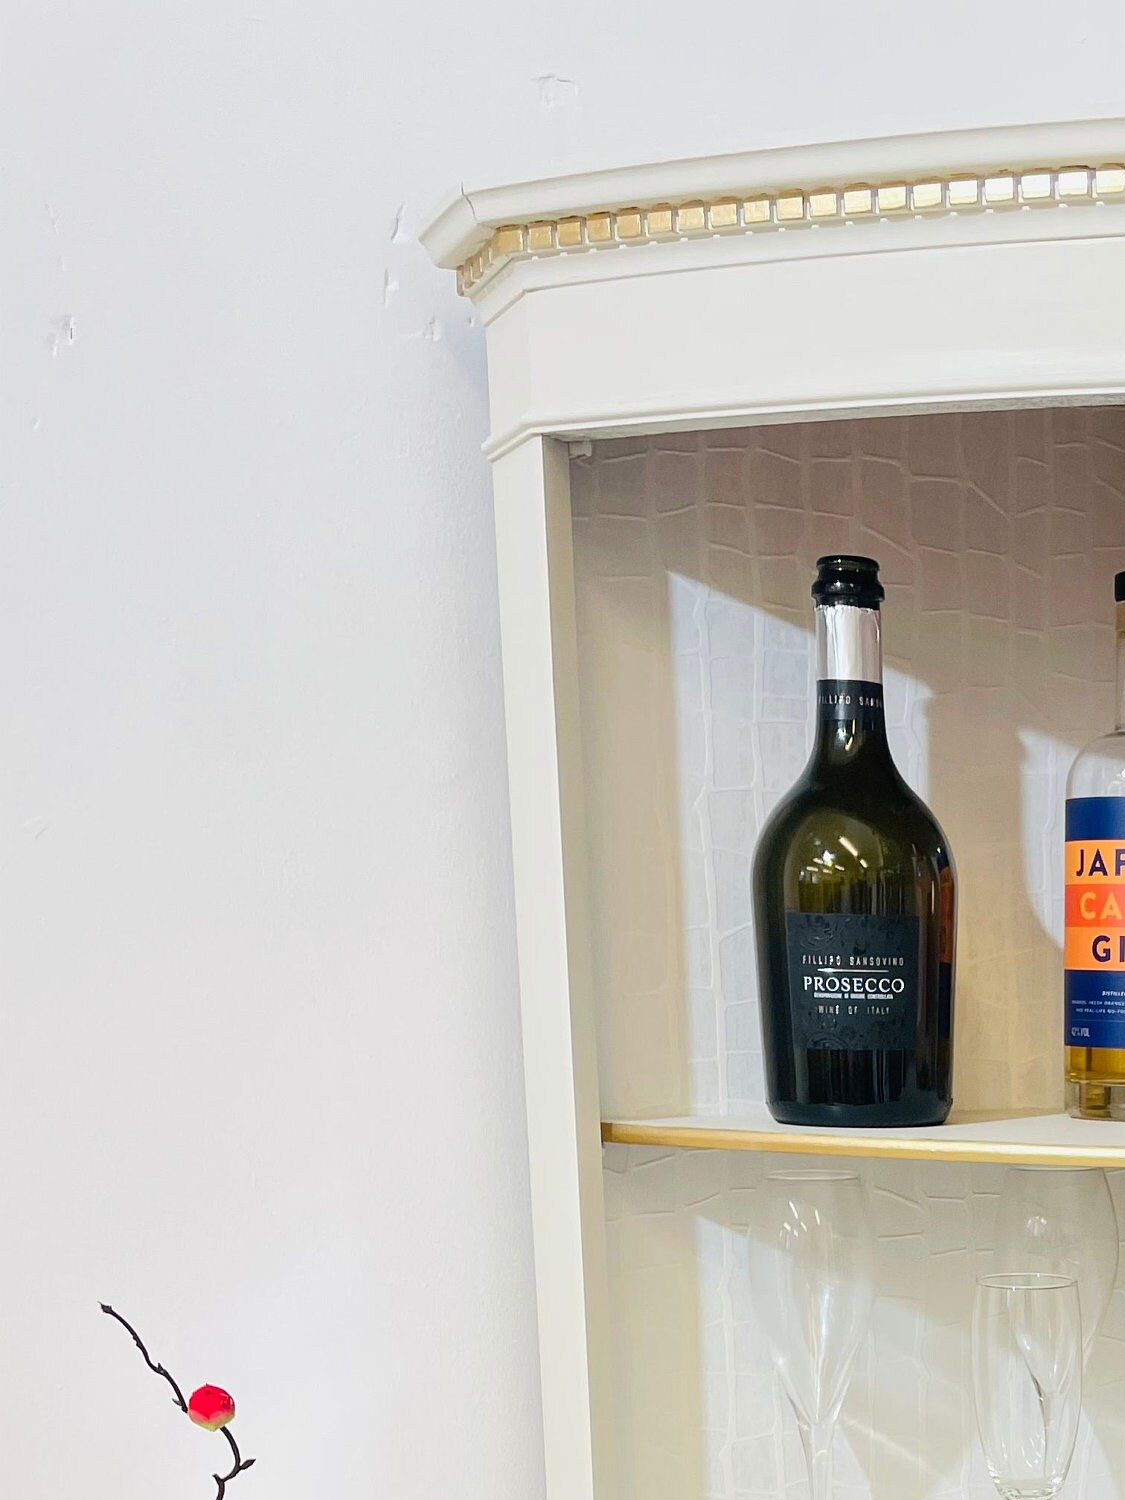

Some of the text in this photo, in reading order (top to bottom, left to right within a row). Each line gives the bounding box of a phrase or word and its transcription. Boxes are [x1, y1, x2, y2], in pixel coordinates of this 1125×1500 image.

[802, 954, 842, 966] FILLIPO
[803, 976, 905, 993] PROSECCO
[867, 1005, 890, 1015] ITALY
